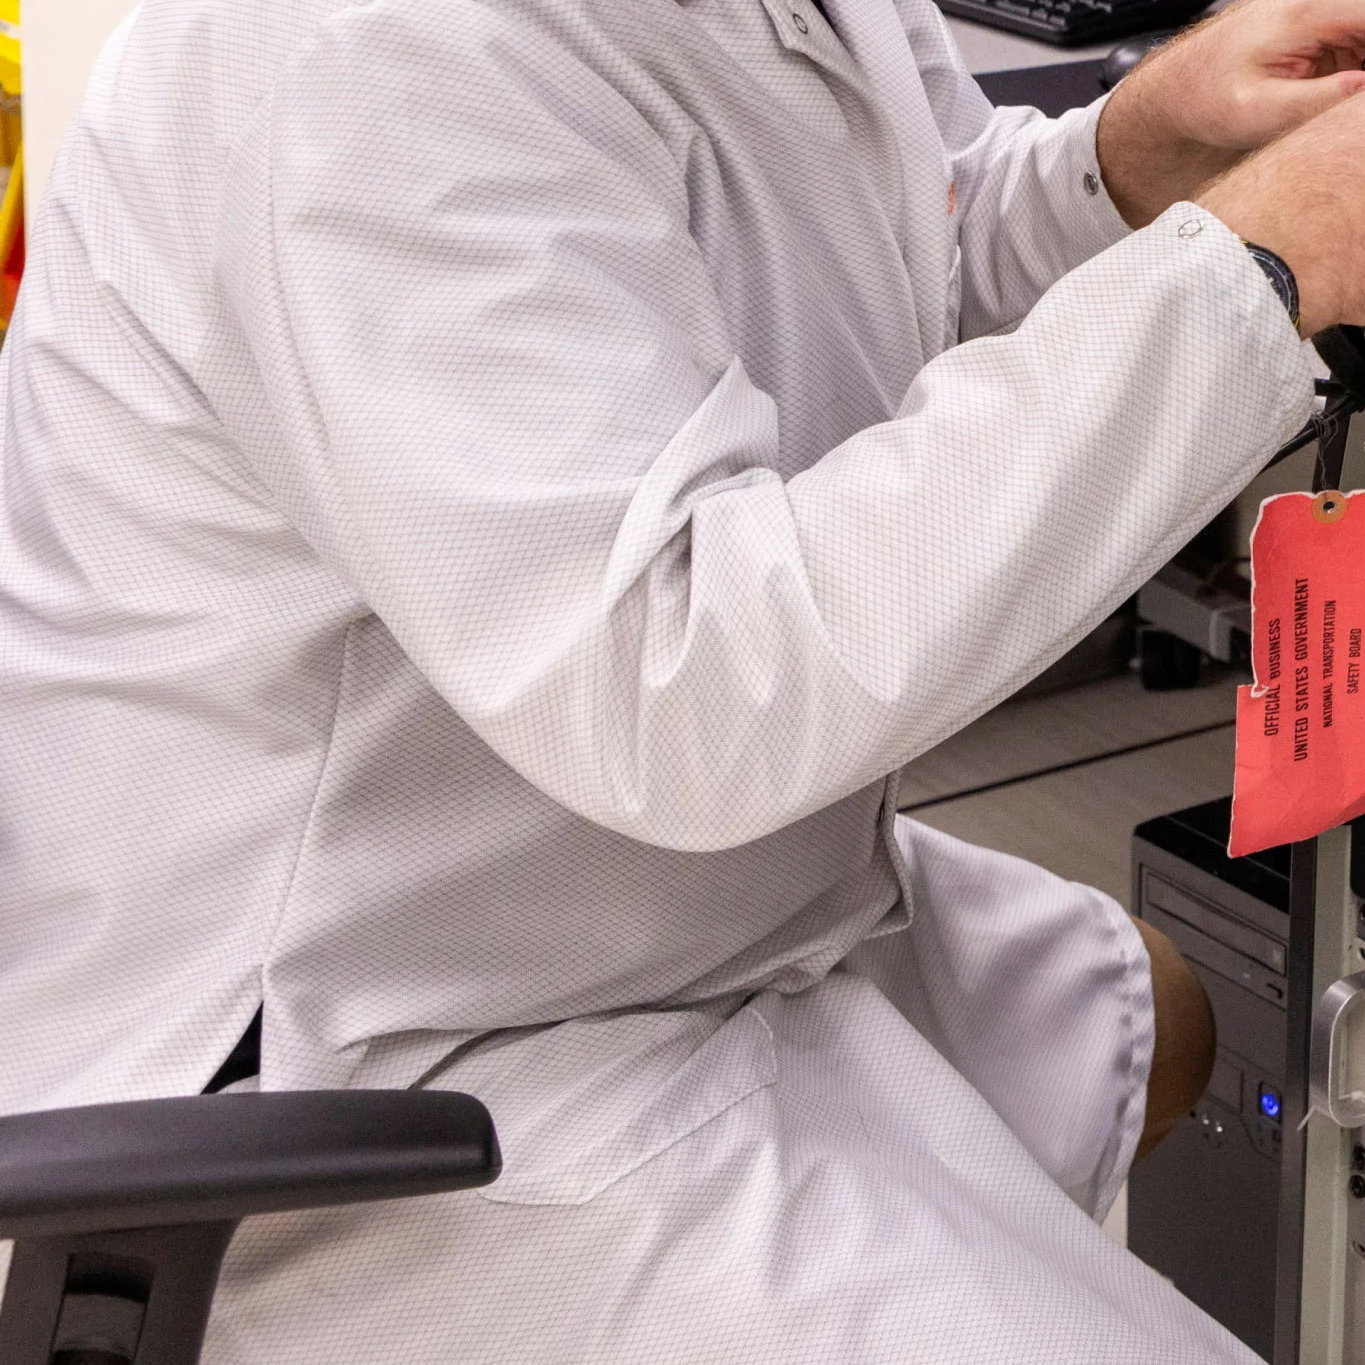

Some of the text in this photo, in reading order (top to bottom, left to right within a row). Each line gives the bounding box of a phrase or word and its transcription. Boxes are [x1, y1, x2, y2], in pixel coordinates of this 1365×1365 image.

[1264, 618, 1281, 737] OFFICIAL BUSINESS
[1294, 578, 1308, 762] UNITED STATES GOVERNMENT
[1323, 600, 1336, 728] NATIONAL TRANSPORTATION
[1347, 628, 1362, 694] SAFETY BOARD
